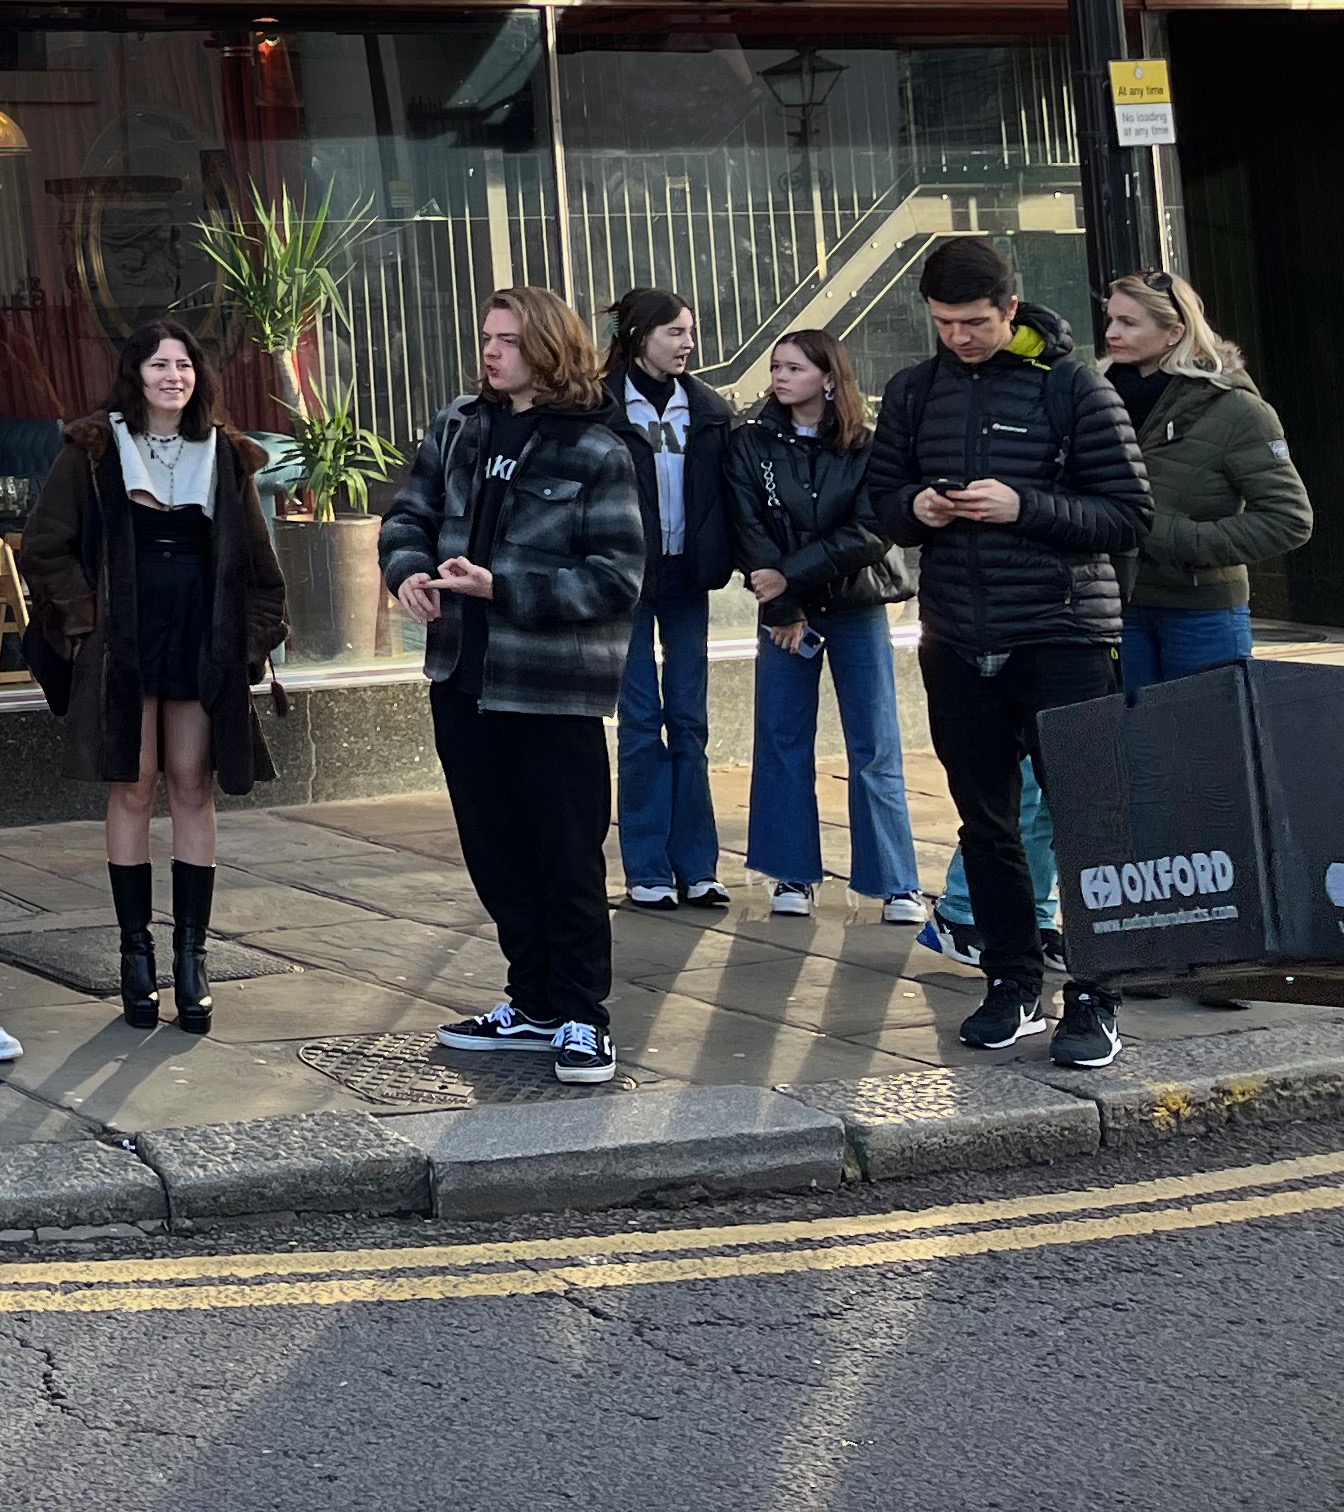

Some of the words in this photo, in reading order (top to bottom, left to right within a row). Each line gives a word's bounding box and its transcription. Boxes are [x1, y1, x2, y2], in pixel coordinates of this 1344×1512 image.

[1118, 86, 1127, 96] At
[1129, 87, 1144, 98] any
[1145, 86, 1164, 95] time
[1122, 112, 1135, 123] No
[1136, 112, 1168, 124] loading
[1134, 128, 1149, 138] any
[1151, 126, 1169, 135] time
[1121, 850, 1234, 904] OXFORD
